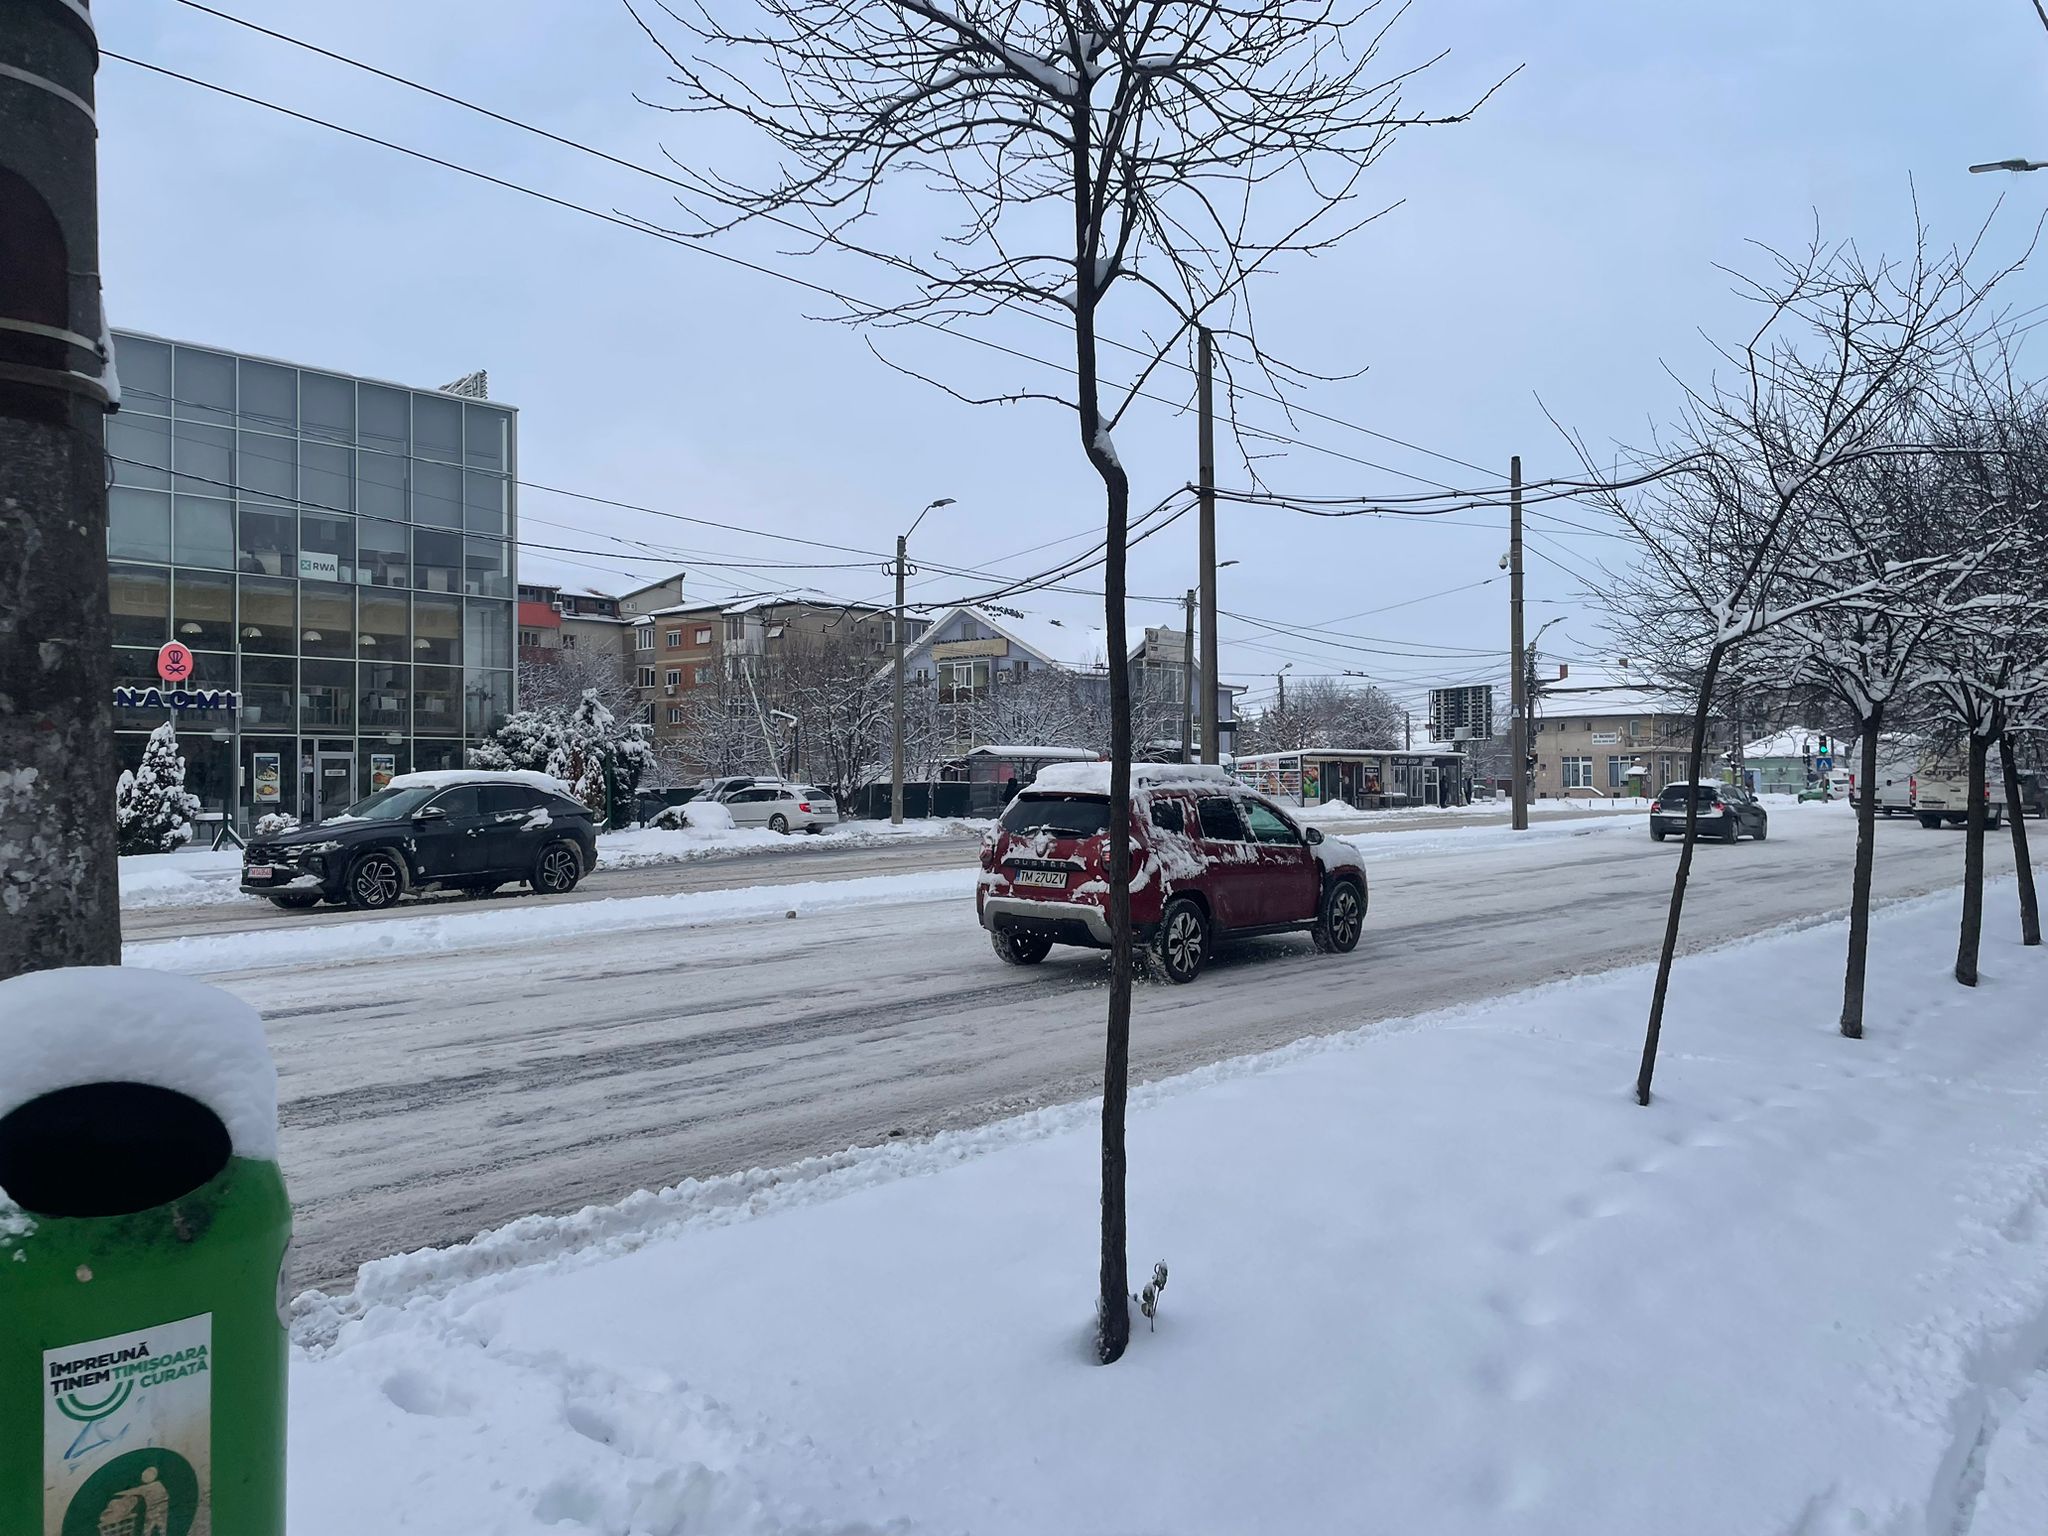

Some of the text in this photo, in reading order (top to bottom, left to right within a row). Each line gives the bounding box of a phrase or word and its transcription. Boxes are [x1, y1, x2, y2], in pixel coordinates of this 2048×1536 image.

[312, 562, 336, 572] RWA
[116, 688, 234, 711] NAOMI
[1014, 859, 1067, 868] DUSTER
[1021, 871, 1034, 882] TM
[50, 1341, 150, 1377] ÎMPREUNĂ
[50, 1369, 110, 1396] ȚINEM
[139, 1357, 208, 1389] CURATĂ
